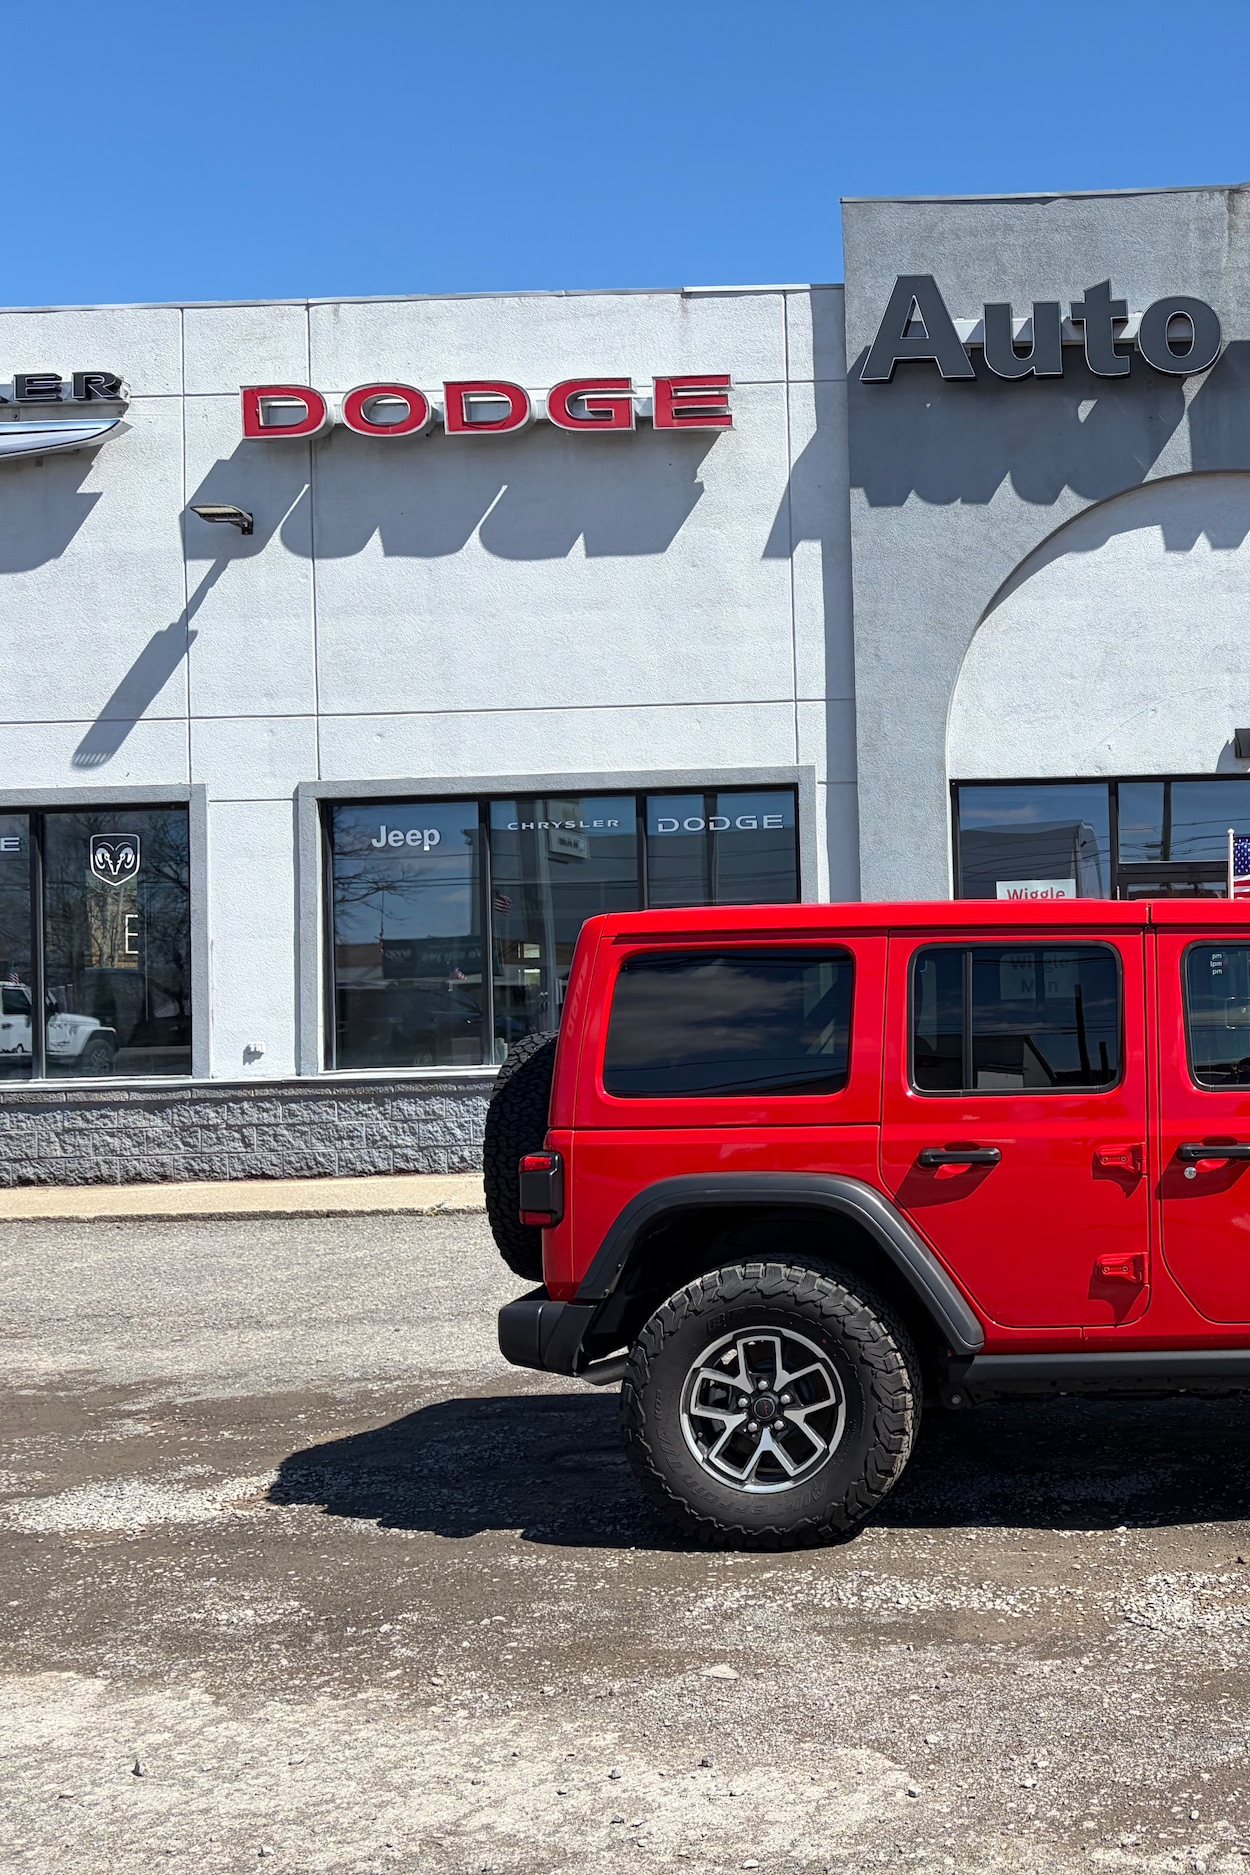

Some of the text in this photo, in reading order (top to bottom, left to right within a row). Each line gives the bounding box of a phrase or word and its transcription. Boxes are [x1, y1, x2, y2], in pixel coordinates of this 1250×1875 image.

[860, 274, 1222, 383] Auto
[13, 372, 125, 401] ER
[240, 374, 734, 441] DODGE
[507, 818, 619, 831] CHRYSLER
[657, 814, 784, 833] DODGE
[371, 825, 441, 851] Jeep
[1006, 886, 1066, 899] Wiggle
[1010, 954, 1069, 973] Wigle
[1021, 979, 1058, 993] Mn
